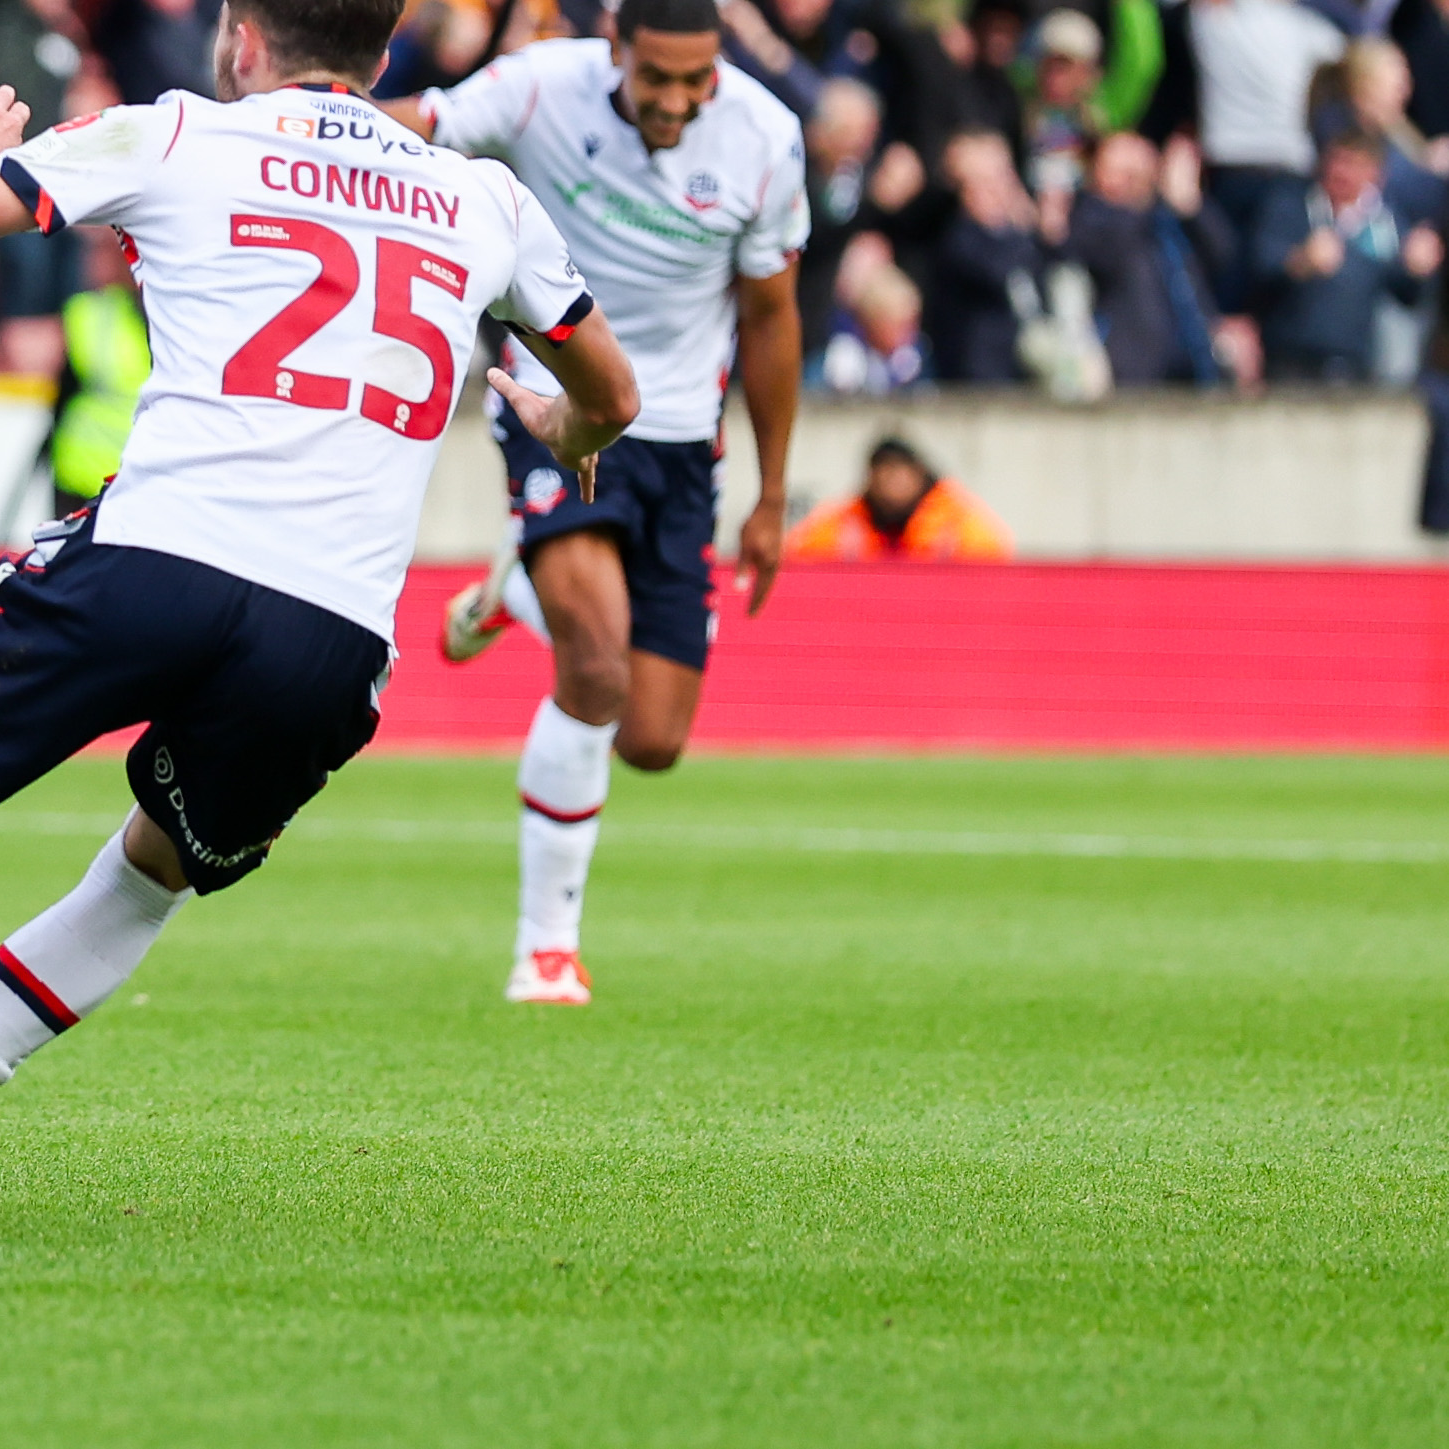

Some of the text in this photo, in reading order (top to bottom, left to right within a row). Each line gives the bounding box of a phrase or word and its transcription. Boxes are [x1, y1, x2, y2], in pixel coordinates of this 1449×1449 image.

[277, 116, 436, 157] ebuye
[260, 155, 460, 229] CONWAY
[221, 214, 470, 441] 25
